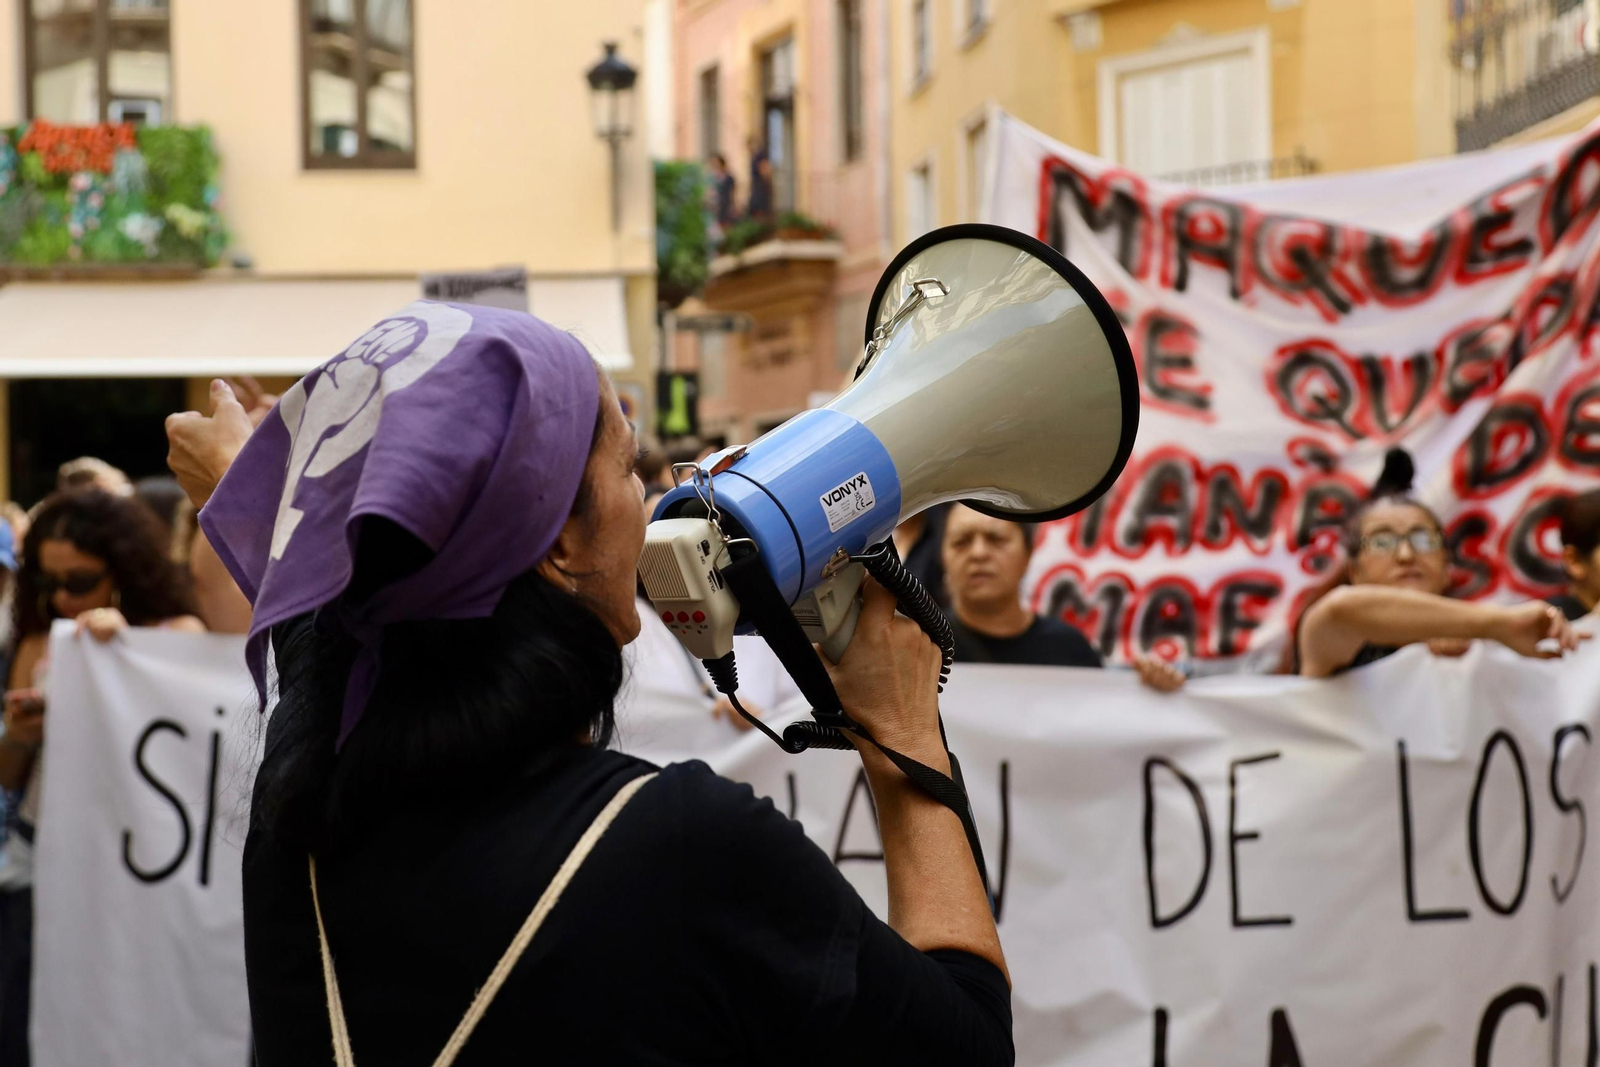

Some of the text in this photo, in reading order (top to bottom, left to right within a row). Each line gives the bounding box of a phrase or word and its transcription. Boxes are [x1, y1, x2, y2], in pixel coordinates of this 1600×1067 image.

[822, 474, 867, 507] VONYX
[121, 708, 226, 884] Si
[1143, 752, 1294, 929] DE
[1397, 723, 1591, 923] LOS
